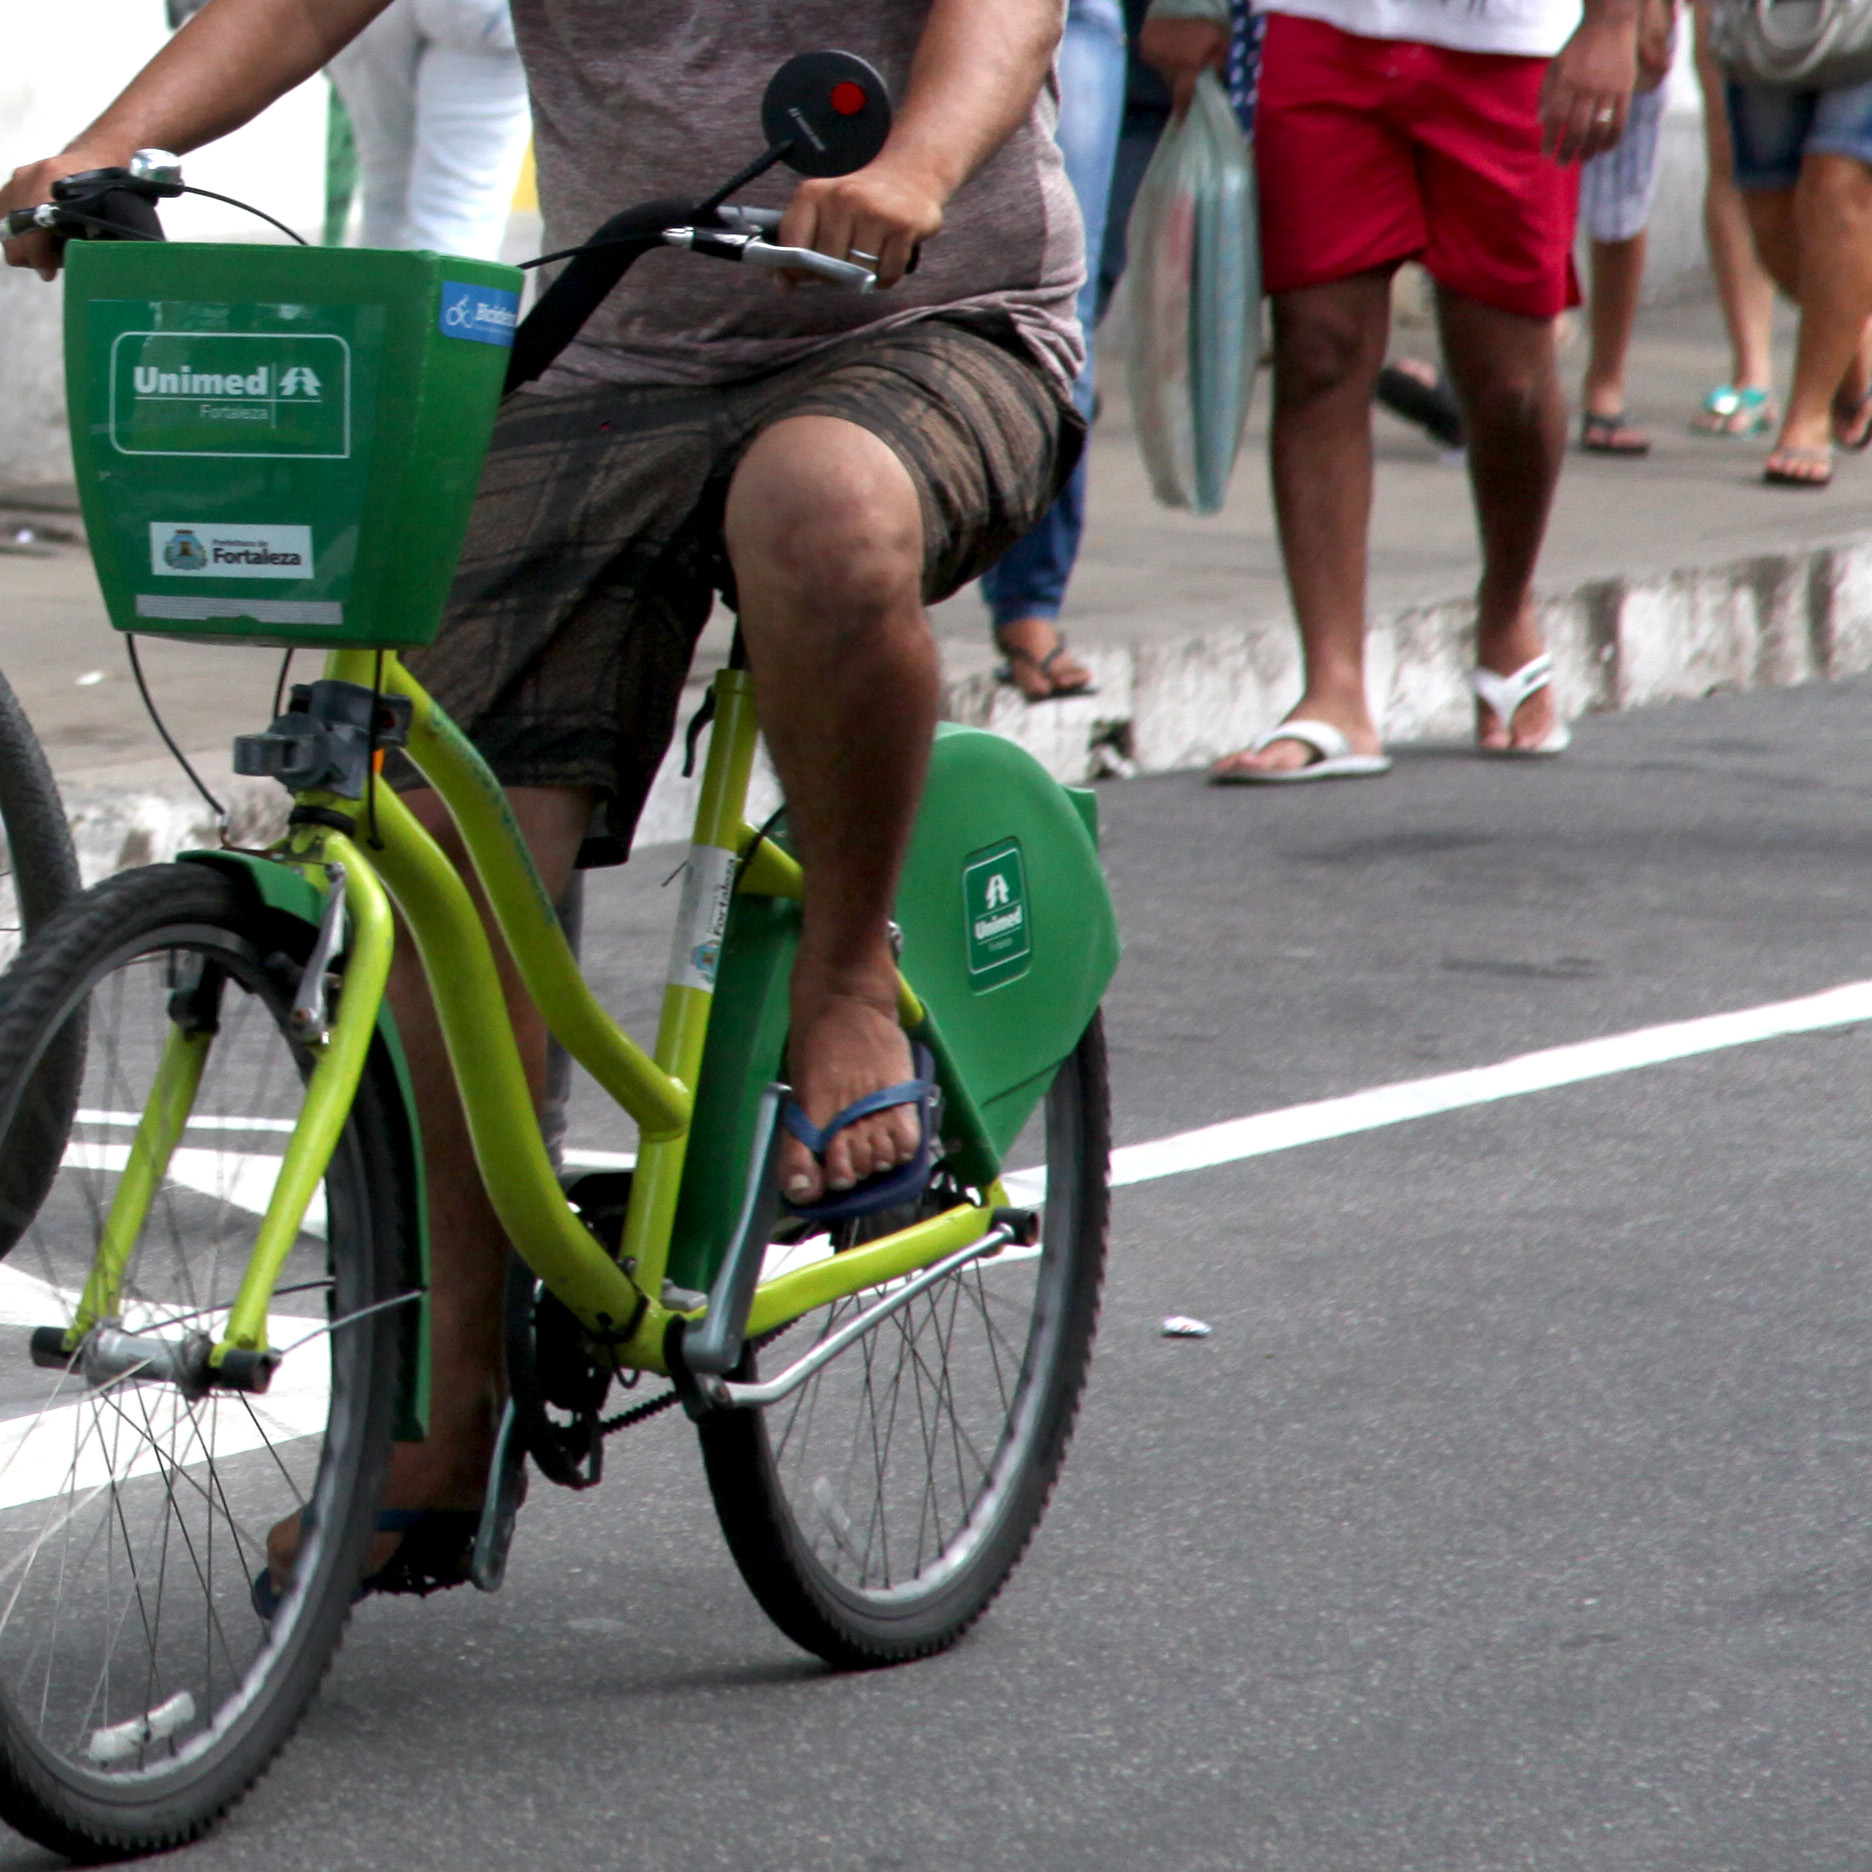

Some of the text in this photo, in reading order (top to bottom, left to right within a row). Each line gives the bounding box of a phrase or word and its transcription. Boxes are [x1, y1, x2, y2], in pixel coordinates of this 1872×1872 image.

[133, 365, 268, 397] Unimed
[200, 402, 269, 422] Fortaleza
[213, 547, 302, 566] Fortaleza
